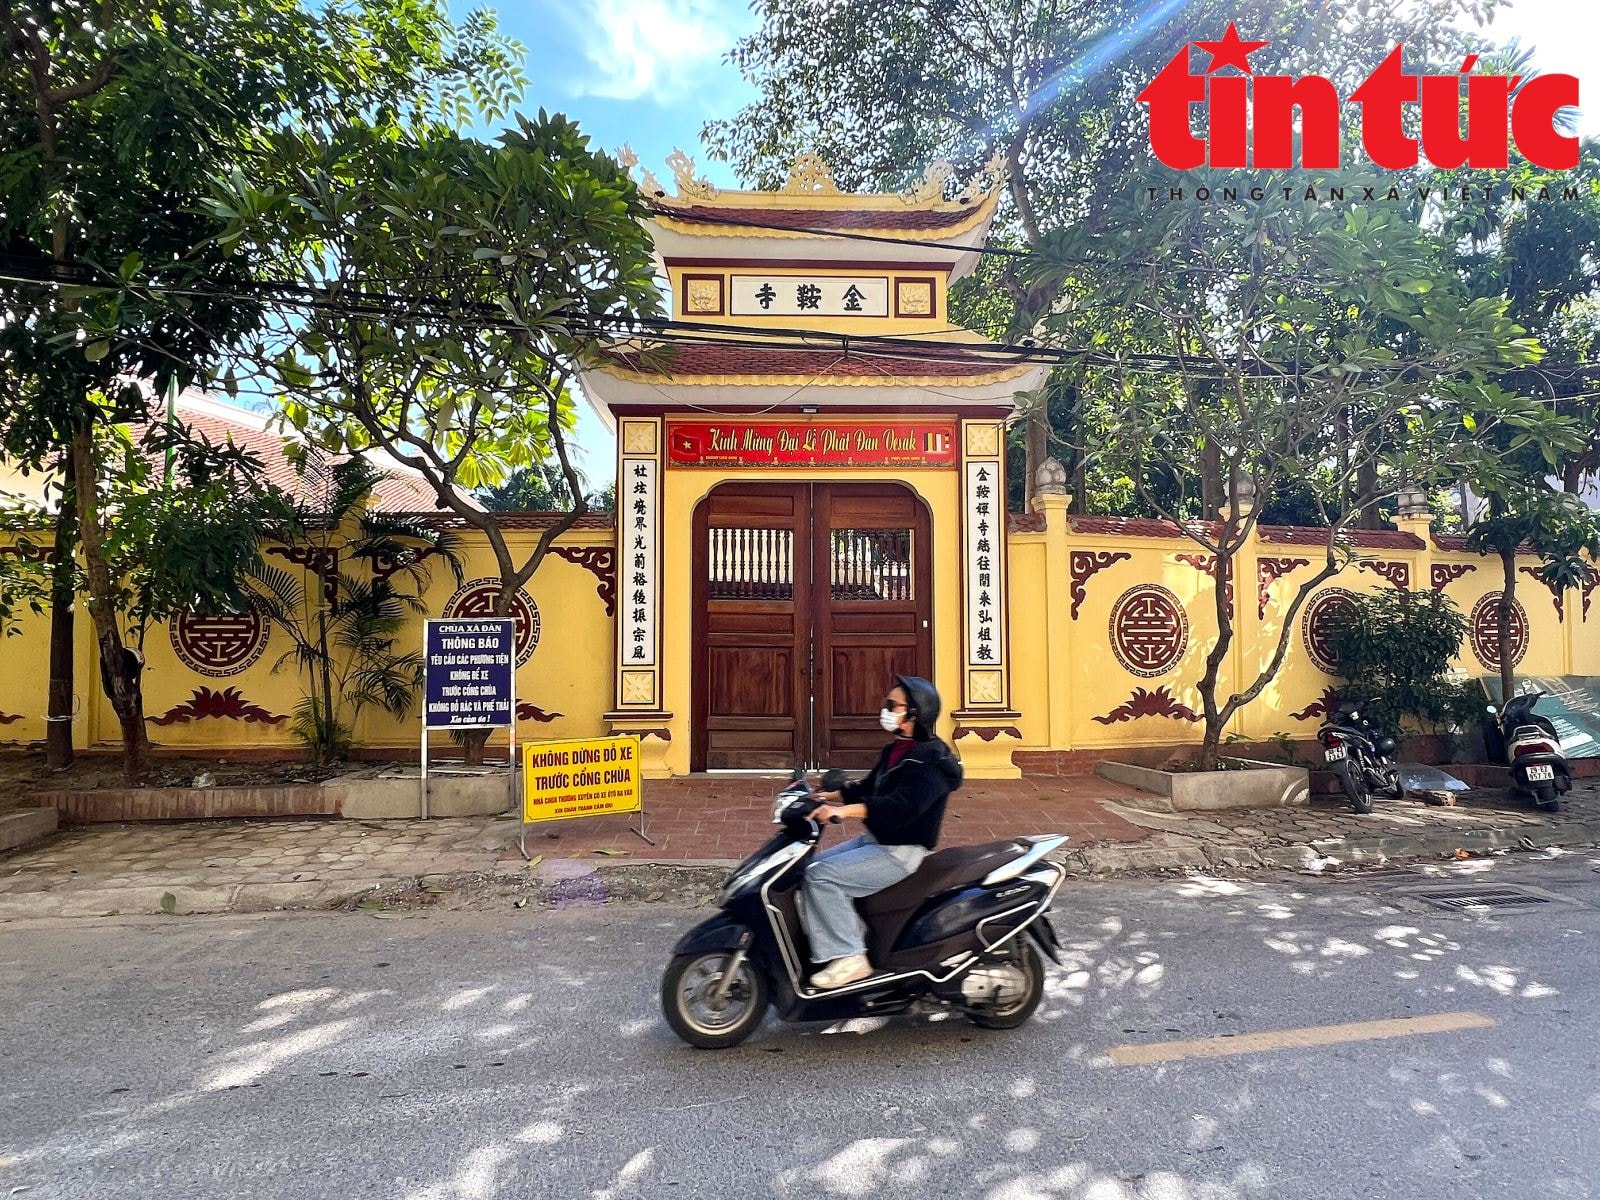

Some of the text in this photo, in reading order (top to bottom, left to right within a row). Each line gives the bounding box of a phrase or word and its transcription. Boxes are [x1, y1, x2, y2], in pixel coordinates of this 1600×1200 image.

[777, 429, 799, 456] Đại
[821, 428, 850, 455] Phật
[438, 623, 465, 633] CHÙA
[441, 635, 500, 649] THÔNG BÁO
[431, 652, 509, 666] YÊU CẦU CÁC PHƯƠNG TIỆN
[450, 668, 471, 681] KHÔNG
[481, 670, 489, 680] XE
[442, 684, 461, 696] TRƯỚC
[480, 684, 497, 696] CHÙA
[428, 701, 450, 713] KHÔNG
[460, 699, 473, 712] RÁC
[473, 700, 482, 711] VÀ
[482, 698, 496, 711] PHẾ
[450, 715, 462, 724] Xin
[532, 750, 569, 769] KHÔNG
[572, 748, 601, 765] DỪNG
[620, 746, 633, 760] XE
[535, 766, 631, 791] TRƯỚC CỔNG CHÙA
